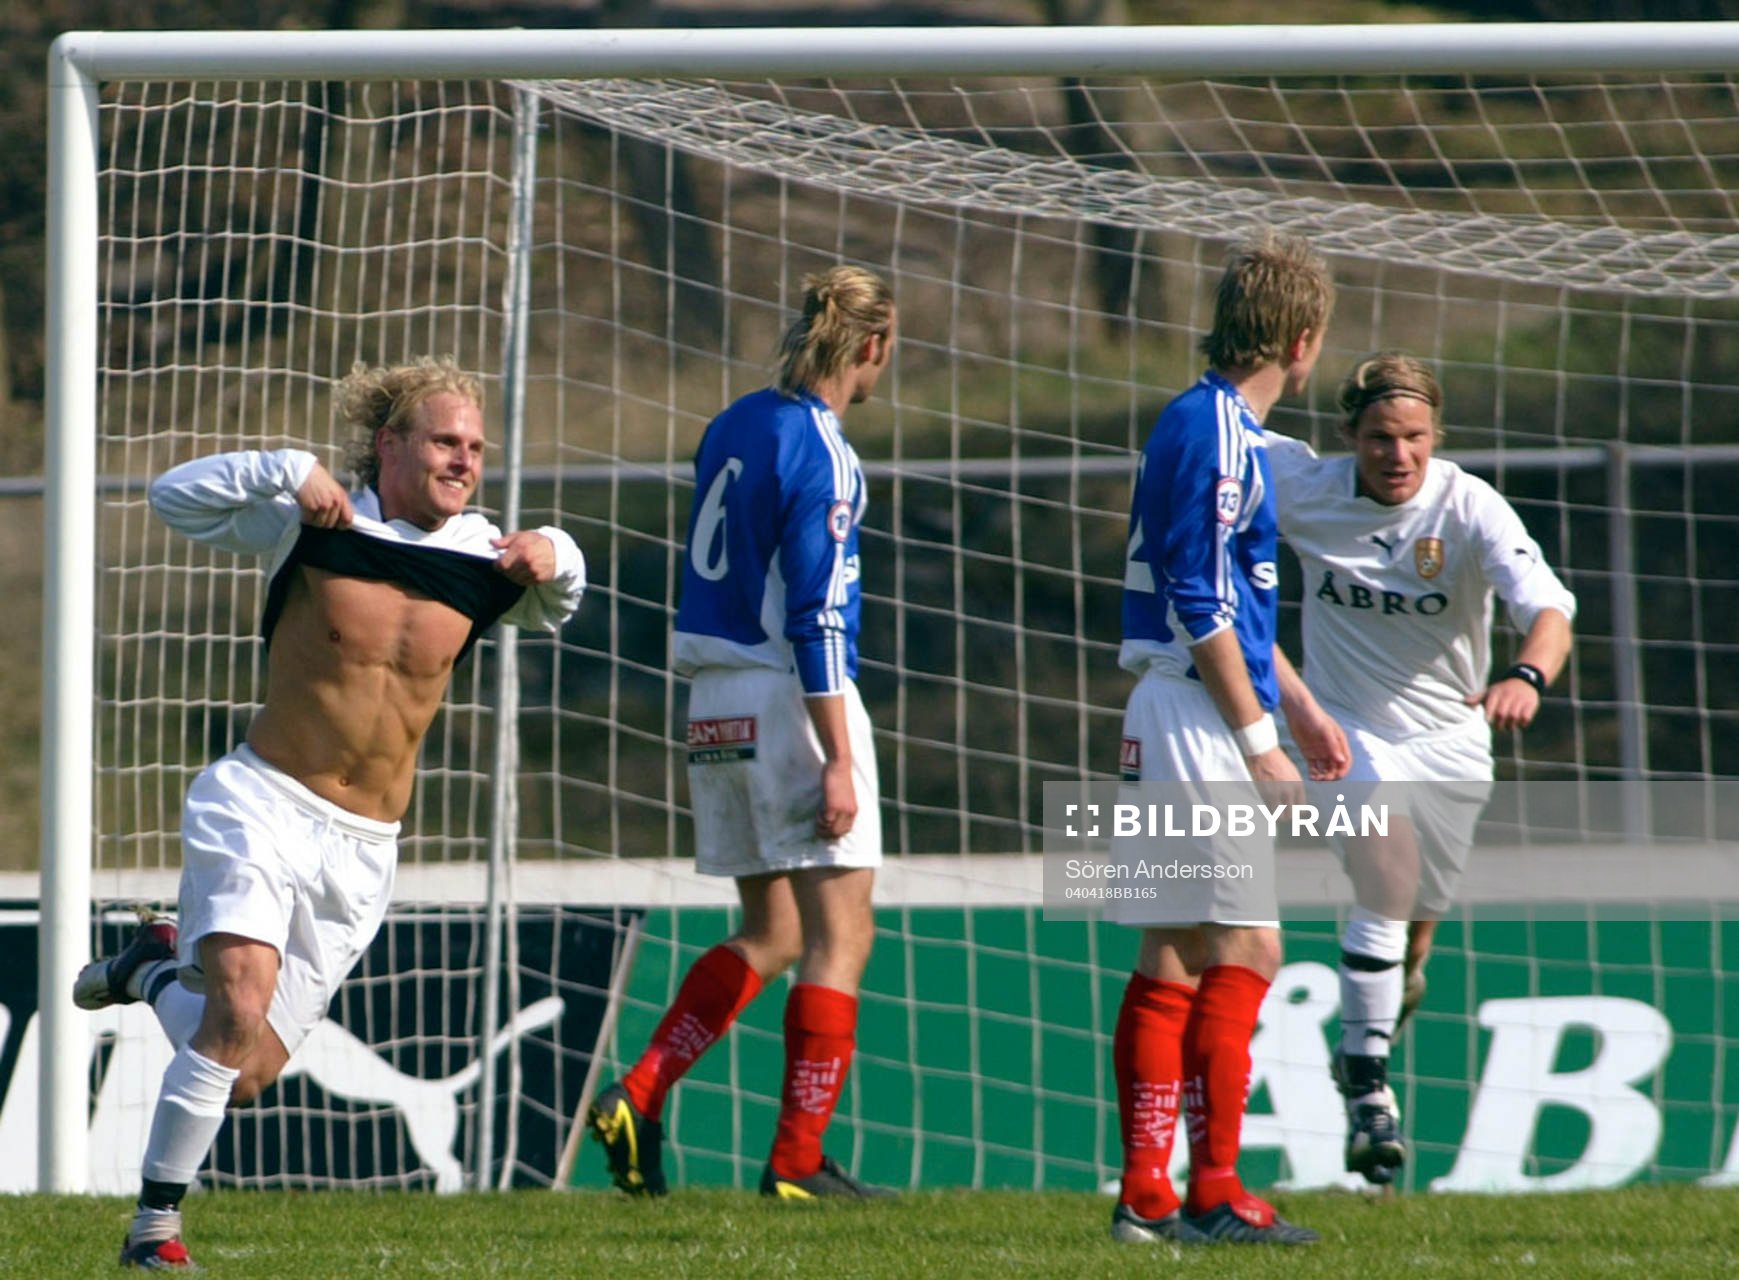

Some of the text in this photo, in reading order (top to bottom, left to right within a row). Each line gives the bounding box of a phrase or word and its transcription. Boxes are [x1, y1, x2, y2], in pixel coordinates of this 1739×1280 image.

[691, 457, 744, 581] 6
[1218, 490, 1239, 512] 13
[1316, 570, 1448, 616] ÅBRO
